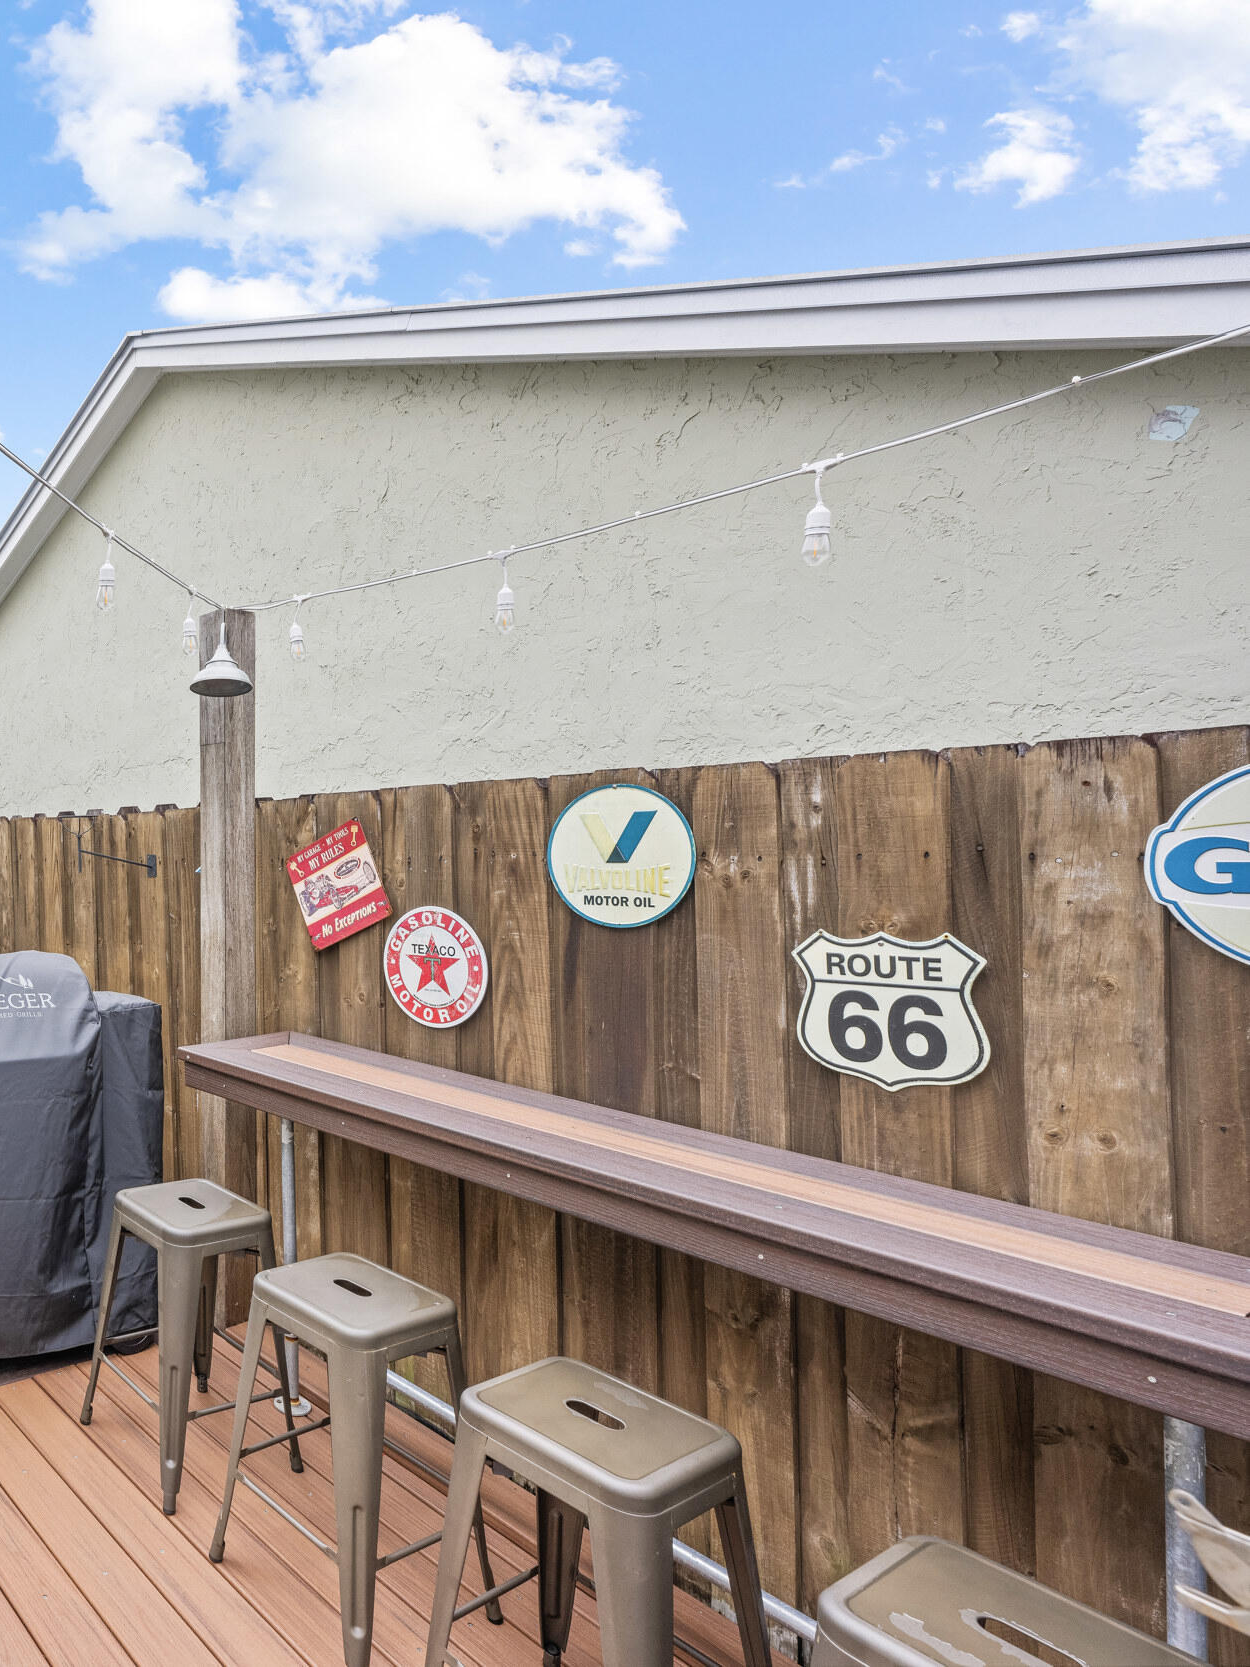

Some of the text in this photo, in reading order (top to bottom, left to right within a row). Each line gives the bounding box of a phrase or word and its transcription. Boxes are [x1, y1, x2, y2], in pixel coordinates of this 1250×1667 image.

[297, 827, 349, 863] MY GARAGE MY TOOLS
[308, 842, 345, 871] MY RULES
[563, 863, 671, 898] VALVOLINE
[583, 895, 656, 908] MOTOR OIL
[391, 912, 479, 959] GASOLINE
[412, 943, 456, 957] TEXACO
[826, 952, 943, 982] ROUTE
[390, 973, 481, 1022] MOTOR OIL
[828, 990, 948, 1071] 66
